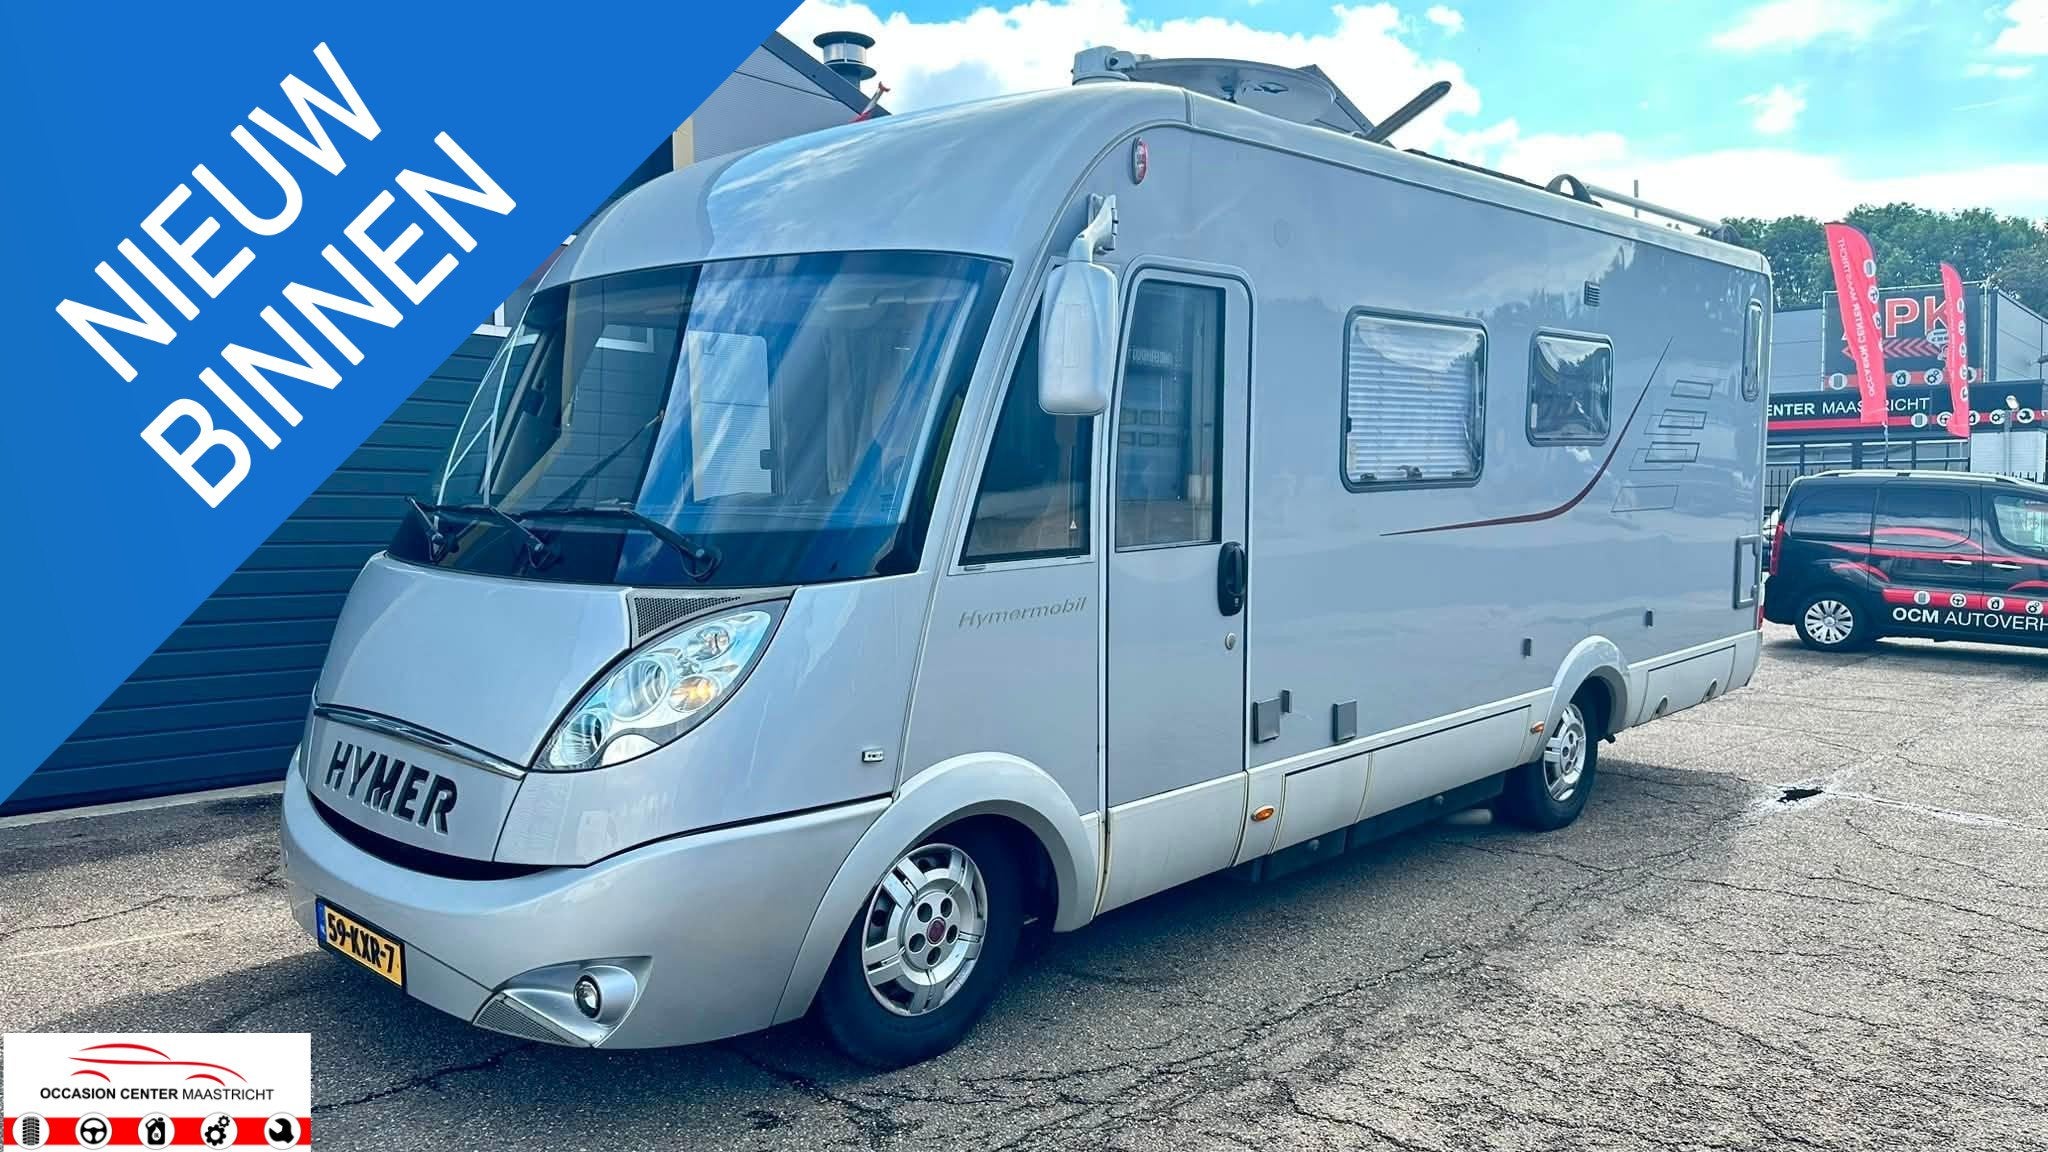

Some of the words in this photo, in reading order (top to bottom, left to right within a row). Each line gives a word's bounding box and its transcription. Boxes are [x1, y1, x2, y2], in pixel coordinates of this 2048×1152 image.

[1841, 296, 1949, 341] PK
[958, 596, 1088, 630] Hymermobil
[1892, 607, 1939, 623] OCM
[323, 740, 458, 834] HYMER
[327, 912, 396, 975] 59-KXR-7
